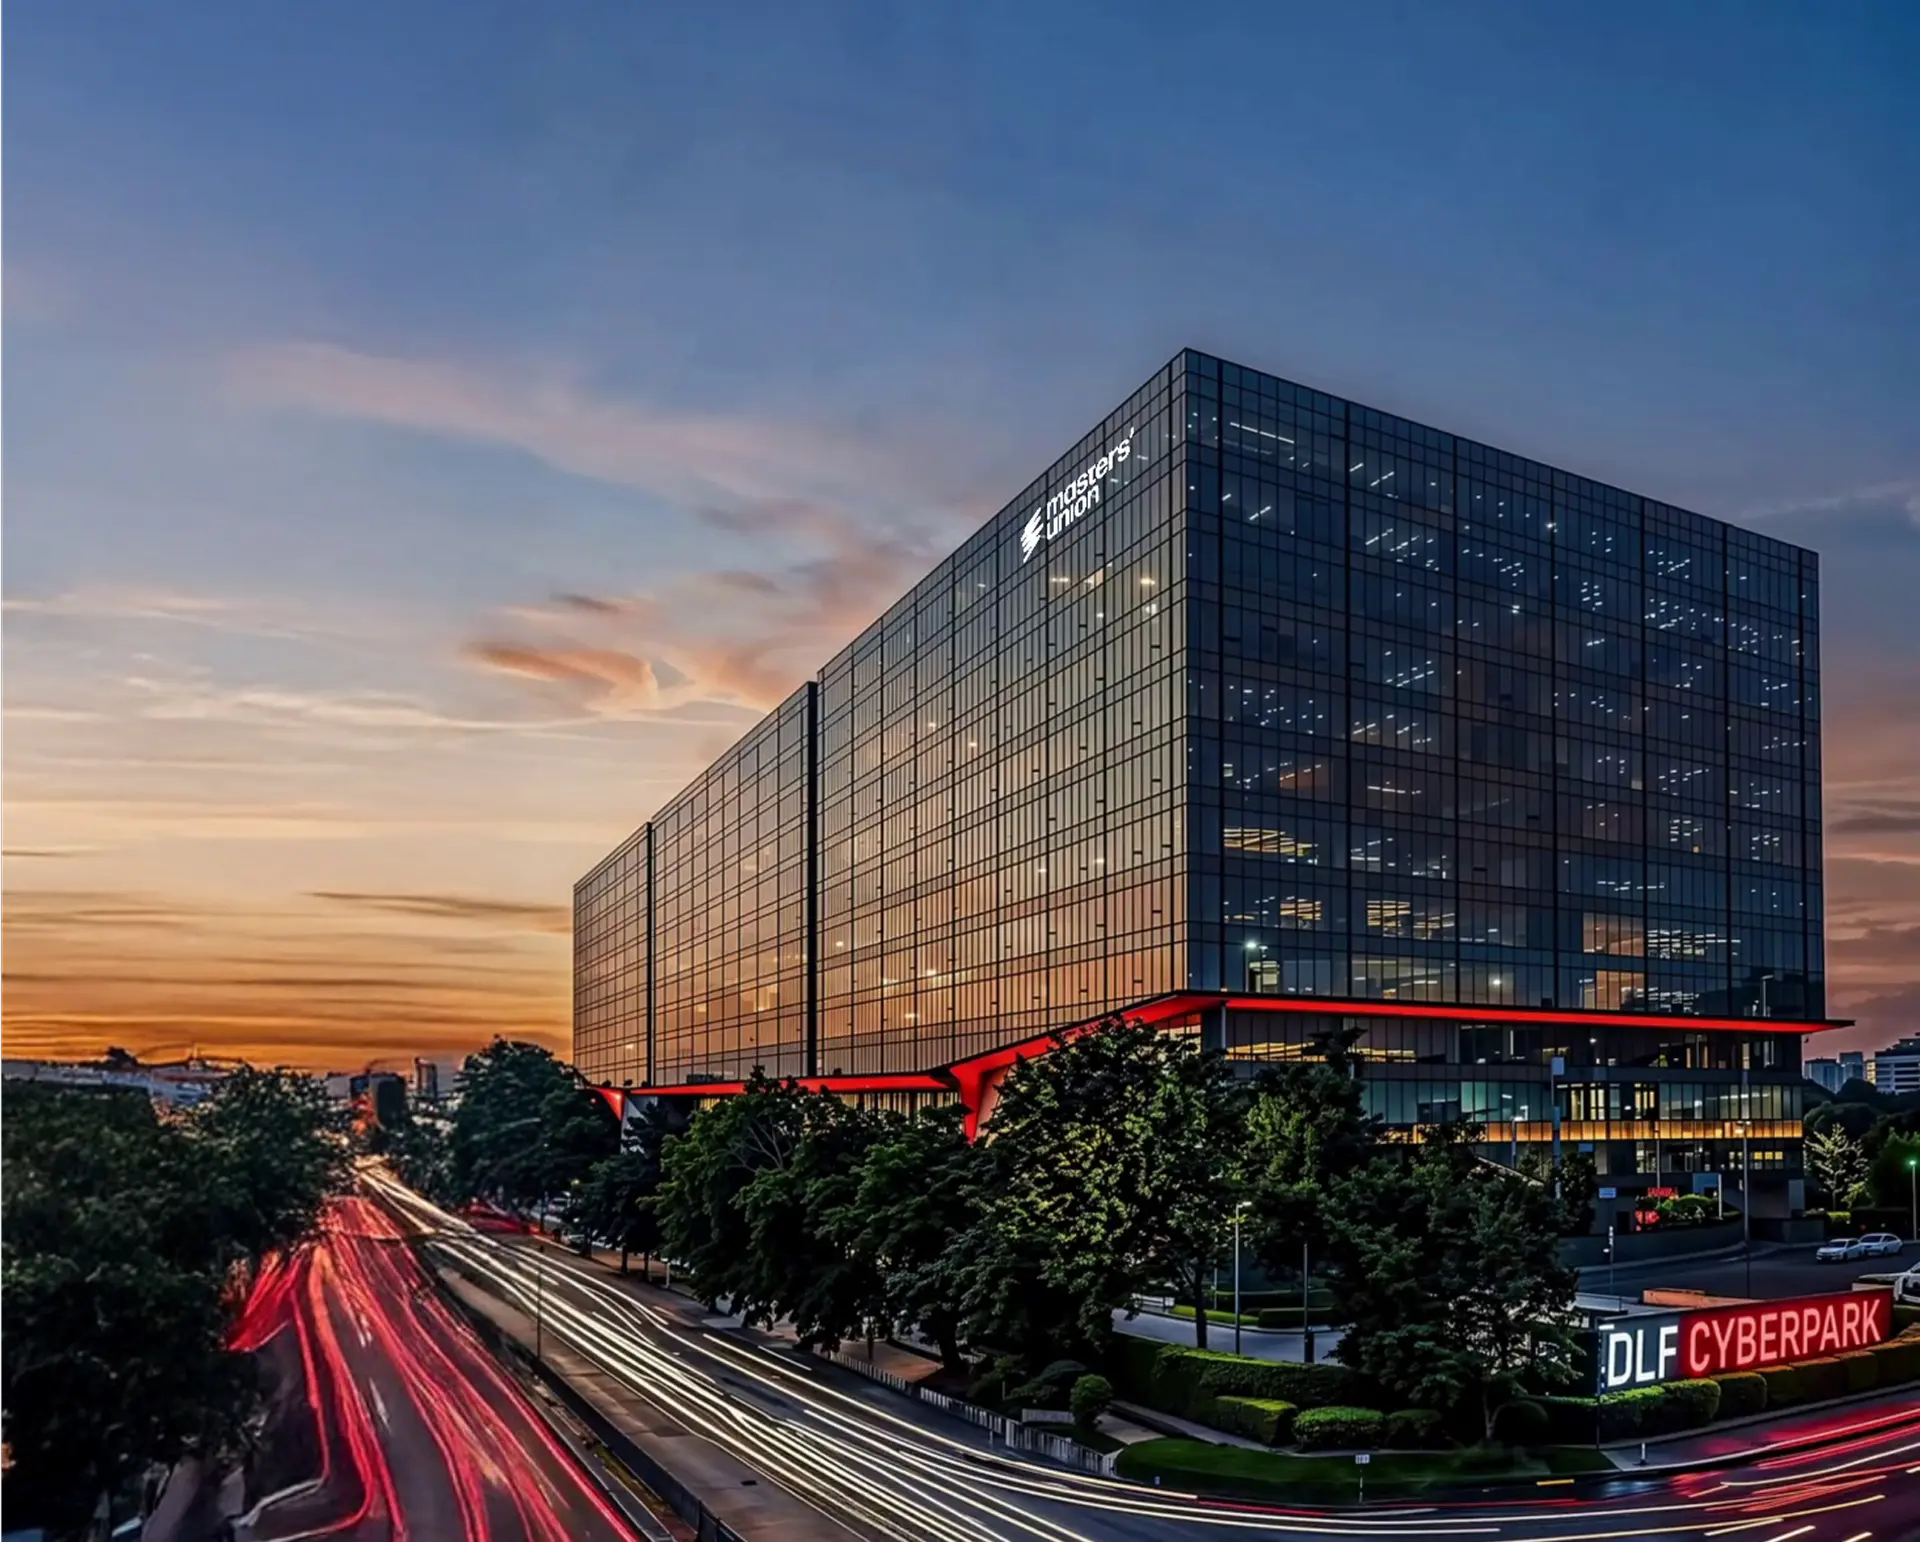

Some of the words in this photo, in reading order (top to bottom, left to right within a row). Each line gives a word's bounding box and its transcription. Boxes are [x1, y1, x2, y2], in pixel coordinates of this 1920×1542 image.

[1047, 427, 1135, 520] masters'
[1047, 485, 1099, 540] union
[1608, 1325, 1678, 1387] DLF
[1690, 1299, 1881, 1372] CYBERPARK
